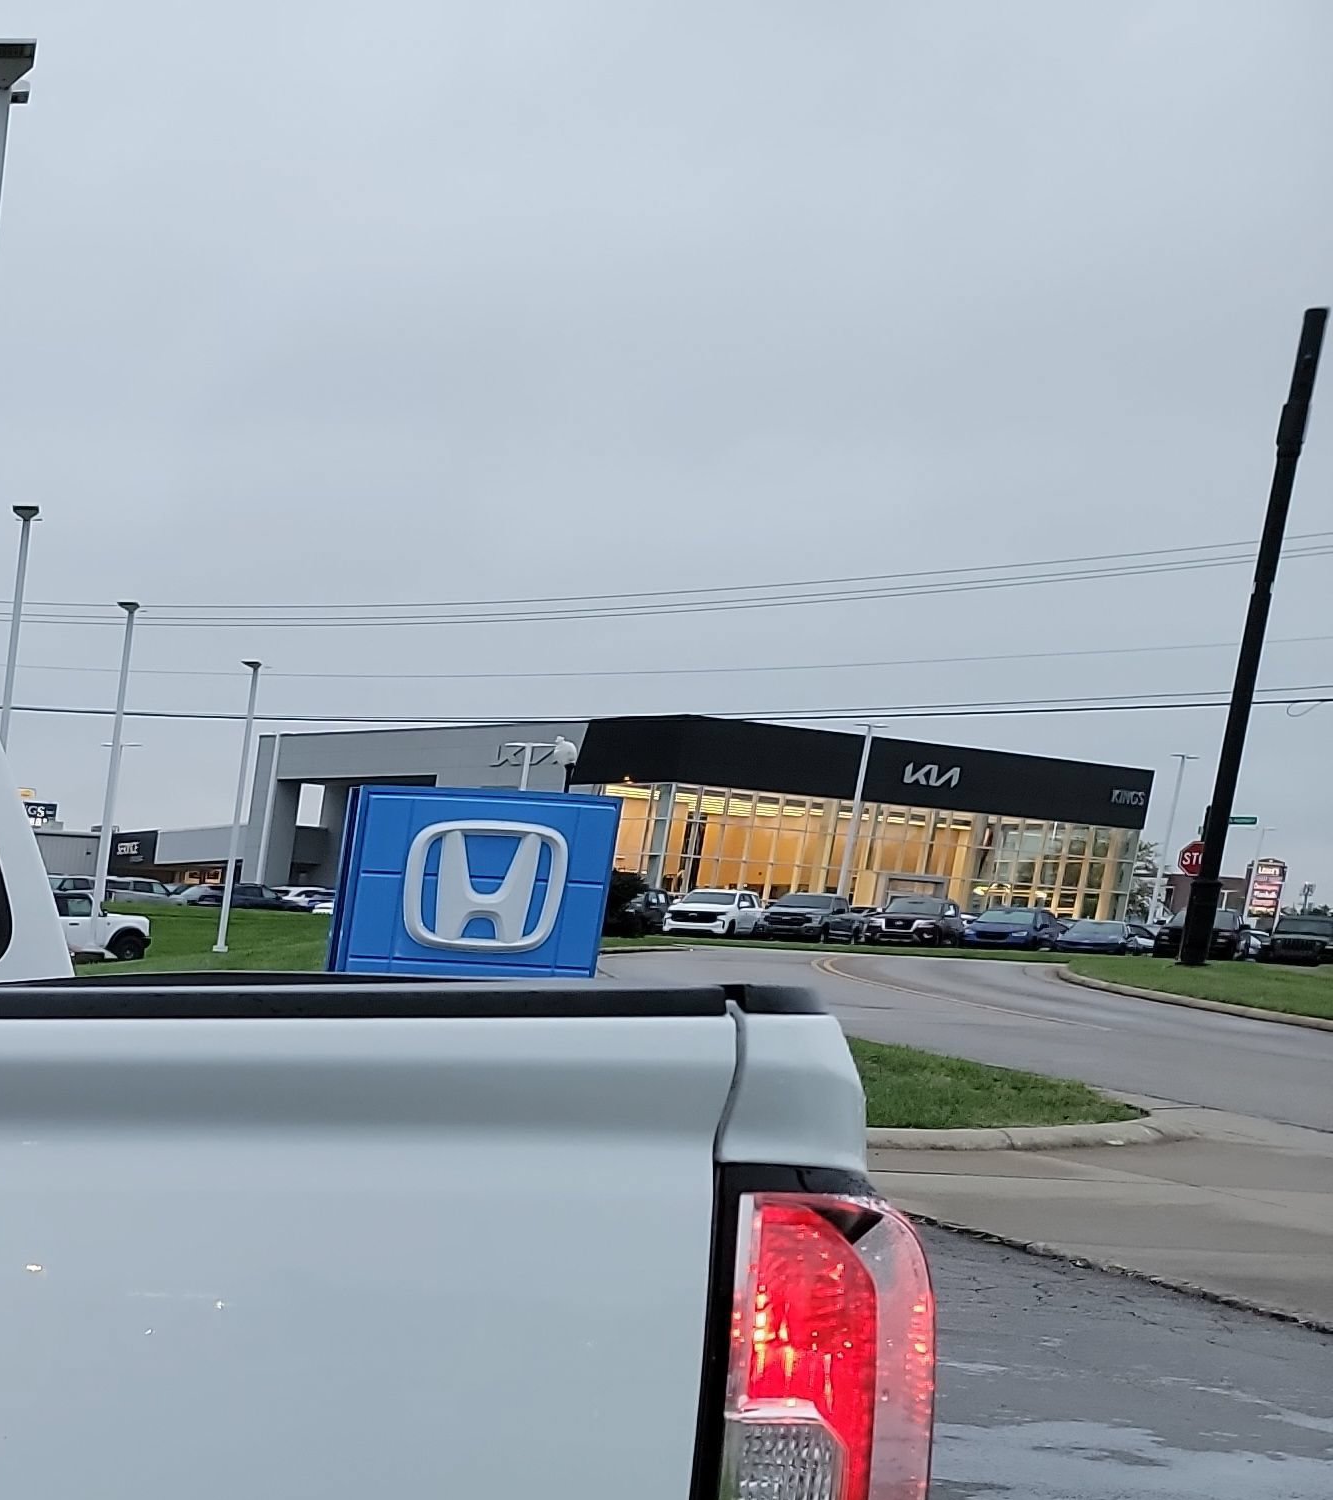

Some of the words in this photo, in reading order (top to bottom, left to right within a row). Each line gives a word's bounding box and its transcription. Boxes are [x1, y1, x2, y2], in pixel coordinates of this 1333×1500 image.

[902, 761, 961, 788] KIA
[1110, 789, 1146, 806] KINGS
[1181, 851, 1204, 866] ST
